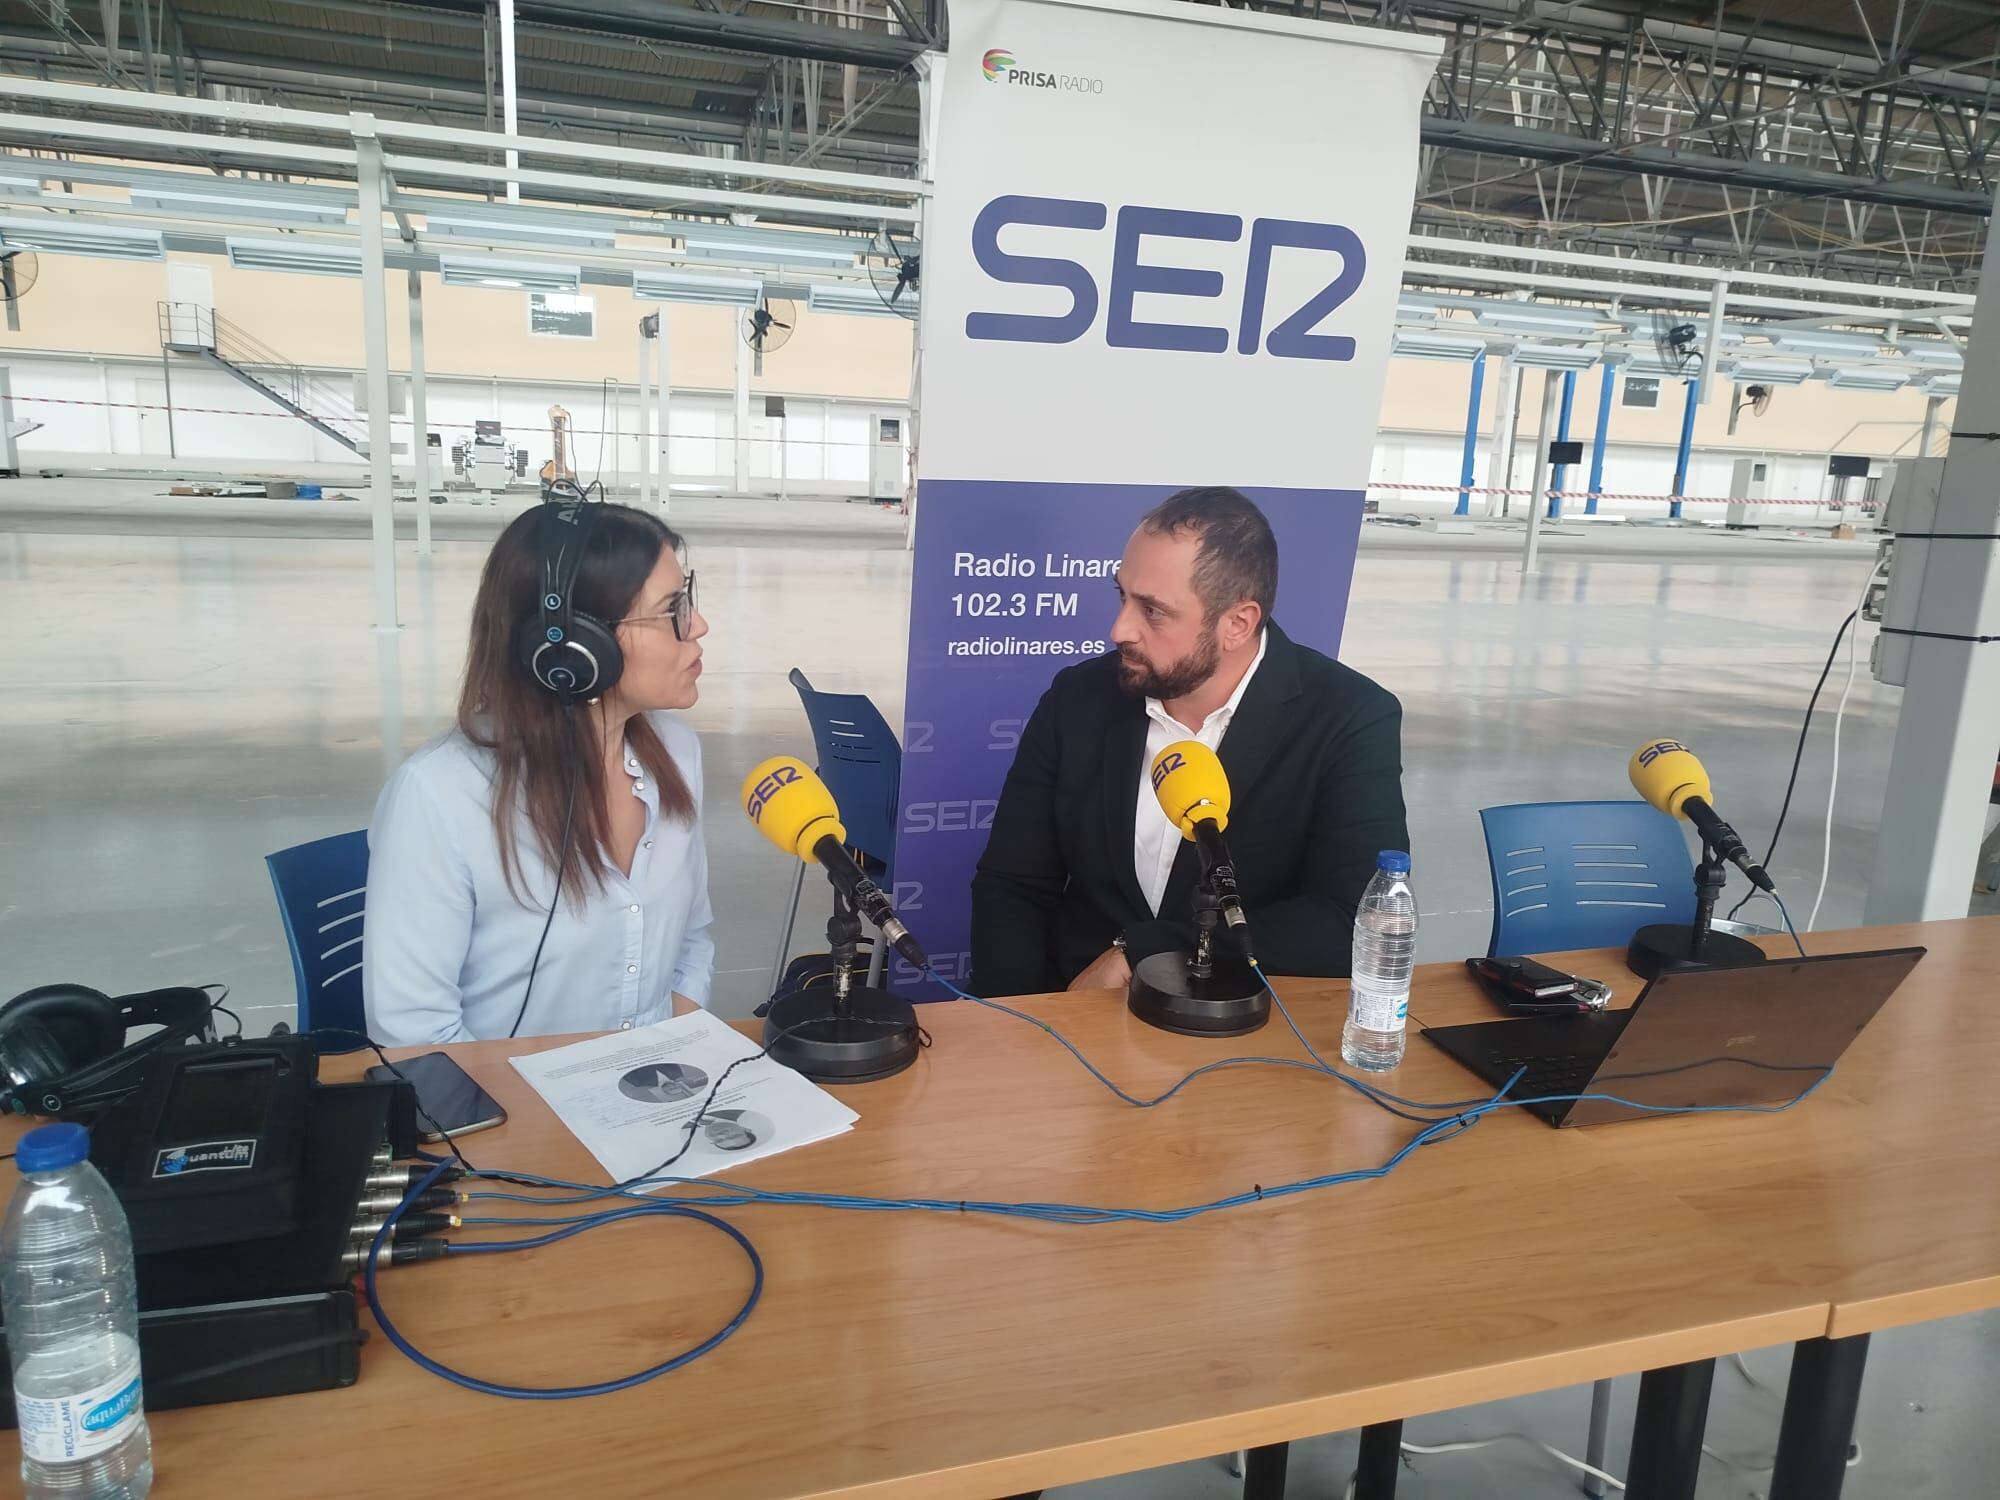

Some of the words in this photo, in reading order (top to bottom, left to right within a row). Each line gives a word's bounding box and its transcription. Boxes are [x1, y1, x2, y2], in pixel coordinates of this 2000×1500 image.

[1008, 69, 1057, 89] PRISA
[1059, 75, 1103, 94] RADIO
[965, 194, 1367, 362] SER
[953, 552, 1036, 577] Radio
[1045, 553, 1122, 577] Linare
[951, 592, 1026, 617] 102.3
[1035, 593, 1078, 617] FM
[947, 637, 1106, 656] radiolinares.es
[1639, 742, 1690, 768] SE
[1152, 752, 1187, 793] ER
[747, 766, 803, 824] SER
[61, 1400, 76, 1458] RECICLAME
